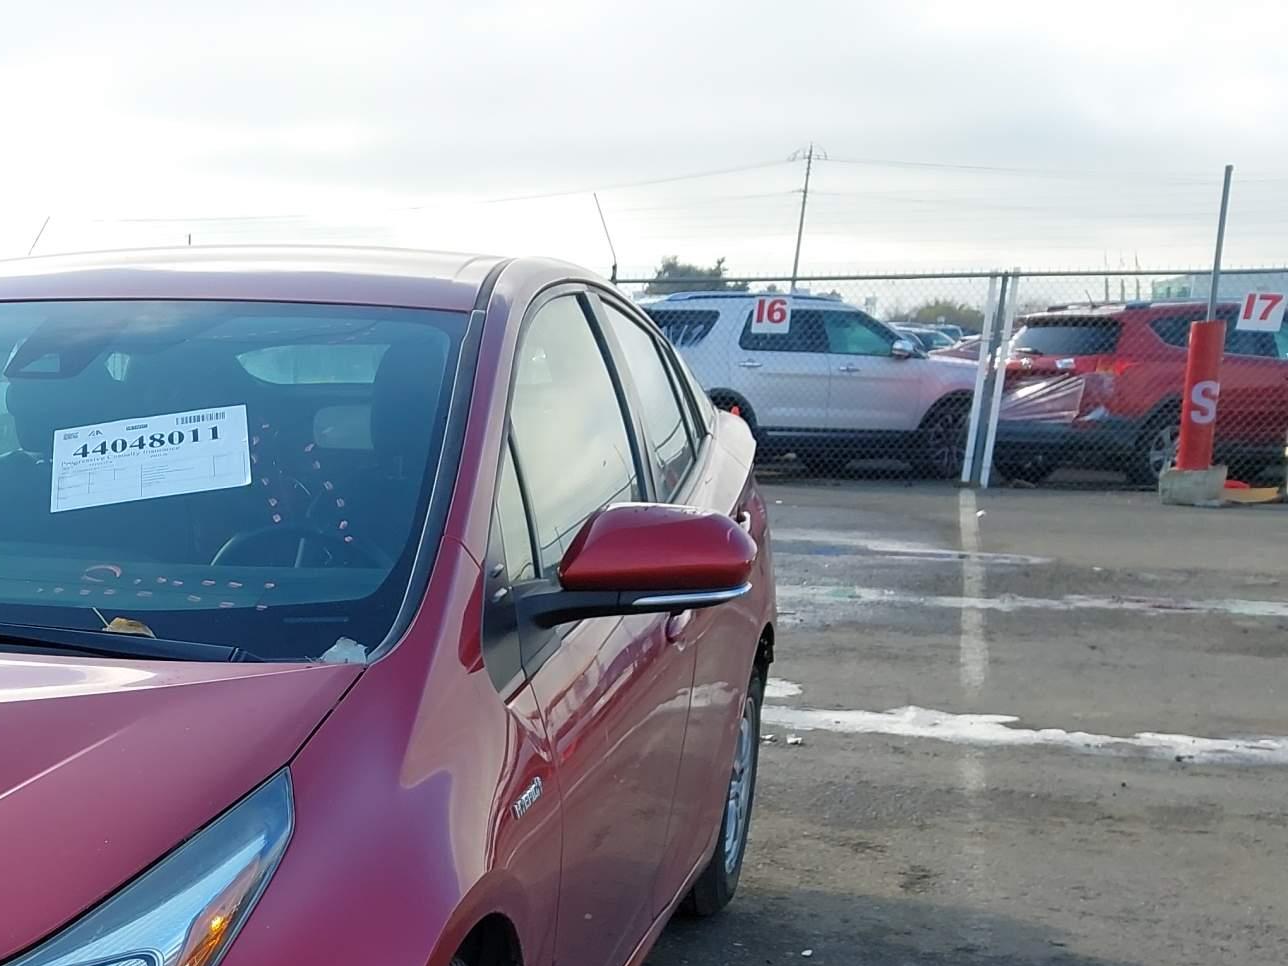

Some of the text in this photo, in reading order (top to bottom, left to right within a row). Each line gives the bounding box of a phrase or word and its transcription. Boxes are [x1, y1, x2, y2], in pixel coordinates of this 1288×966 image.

[756, 298, 788, 324] 16
[1242, 292, 1284, 321] 17
[1190, 380, 1221, 424] S
[72, 425, 222, 458] 44048011
